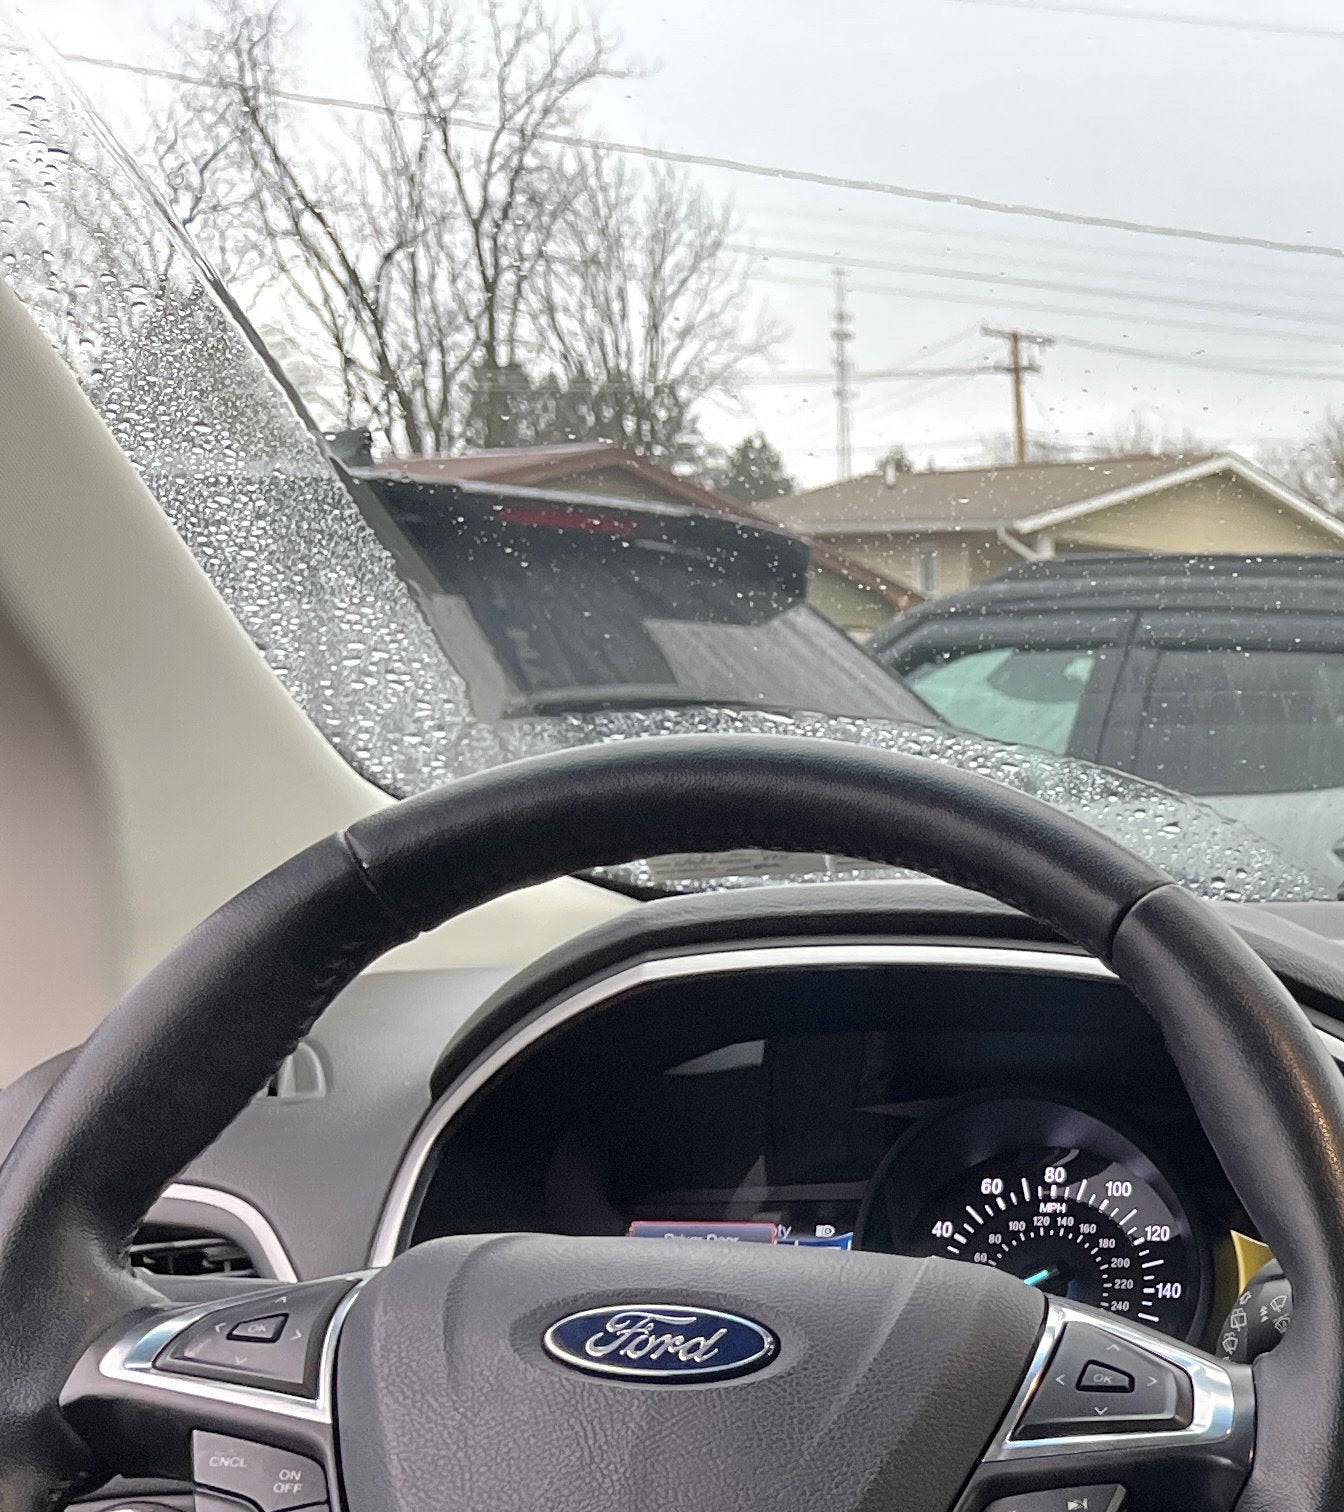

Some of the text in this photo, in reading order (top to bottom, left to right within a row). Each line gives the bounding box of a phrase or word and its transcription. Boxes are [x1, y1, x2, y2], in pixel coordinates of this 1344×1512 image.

[1044, 1167, 1066, 1183] 80
[981, 1178, 1002, 1195] 60
[1105, 1181, 1132, 1197] 100
[1039, 1202, 1066, 1214] MPH
[1008, 1220, 1026, 1232] 100
[1033, 1216, 1051, 1227] 120
[1056, 1216, 1074, 1227] 140
[931, 1220, 953, 1238] 40
[1079, 1223, 1096, 1234] 160
[1145, 1225, 1170, 1242] 120
[988, 1233, 1001, 1245] 80
[1099, 1238, 1116, 1249] 180
[974, 1252, 987, 1264] 60
[1111, 1258, 1130, 1269] 200
[1114, 1279, 1134, 1290] 220
[1156, 1283, 1182, 1299] 140
[1111, 1300, 1130, 1311] 240
[248, 1323, 267, 1334] OK
[585, 1311, 728, 1363] Ford
[1093, 1374, 1113, 1384] OK
[209, 1456, 247, 1468] CNCL
[279, 1469, 301, 1481] ON
[273, 1482, 303, 1494] OFF
